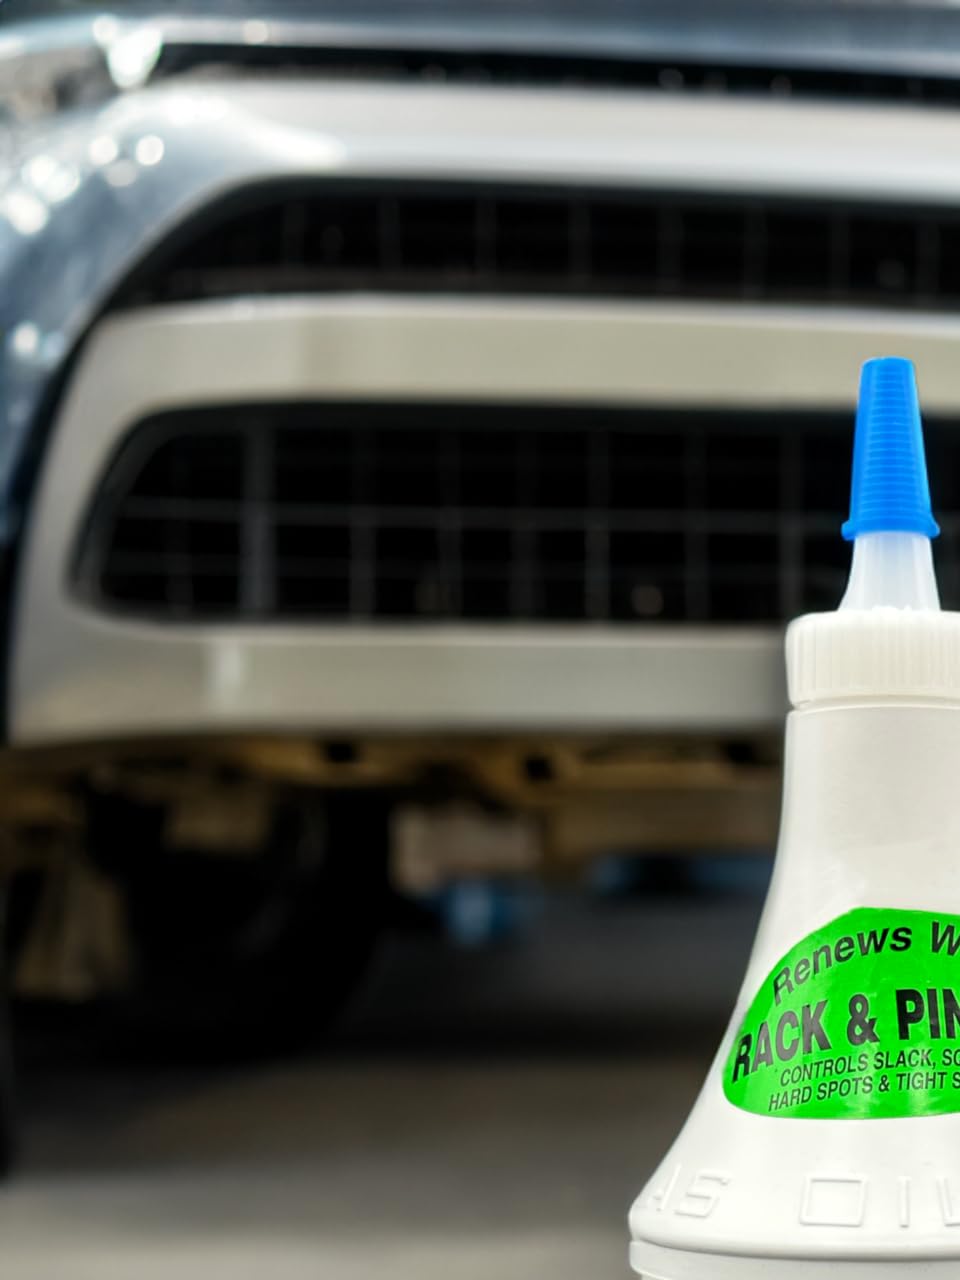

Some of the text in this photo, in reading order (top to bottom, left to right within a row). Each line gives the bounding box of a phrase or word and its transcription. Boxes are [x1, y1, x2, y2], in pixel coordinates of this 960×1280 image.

[771, 925, 913, 1005] Renews
[732, 1003, 832, 1083] RACK
[846, 994, 880, 1046] &
[777, 1053, 869, 1086] CONTROLS
[873, 1048, 937, 1070] SLACK,
[768, 1086, 812, 1112] HARD
[816, 1076, 873, 1101] SPOTS
[878, 1074, 890, 1092] &
[896, 1071, 947, 1090] TIGHT
